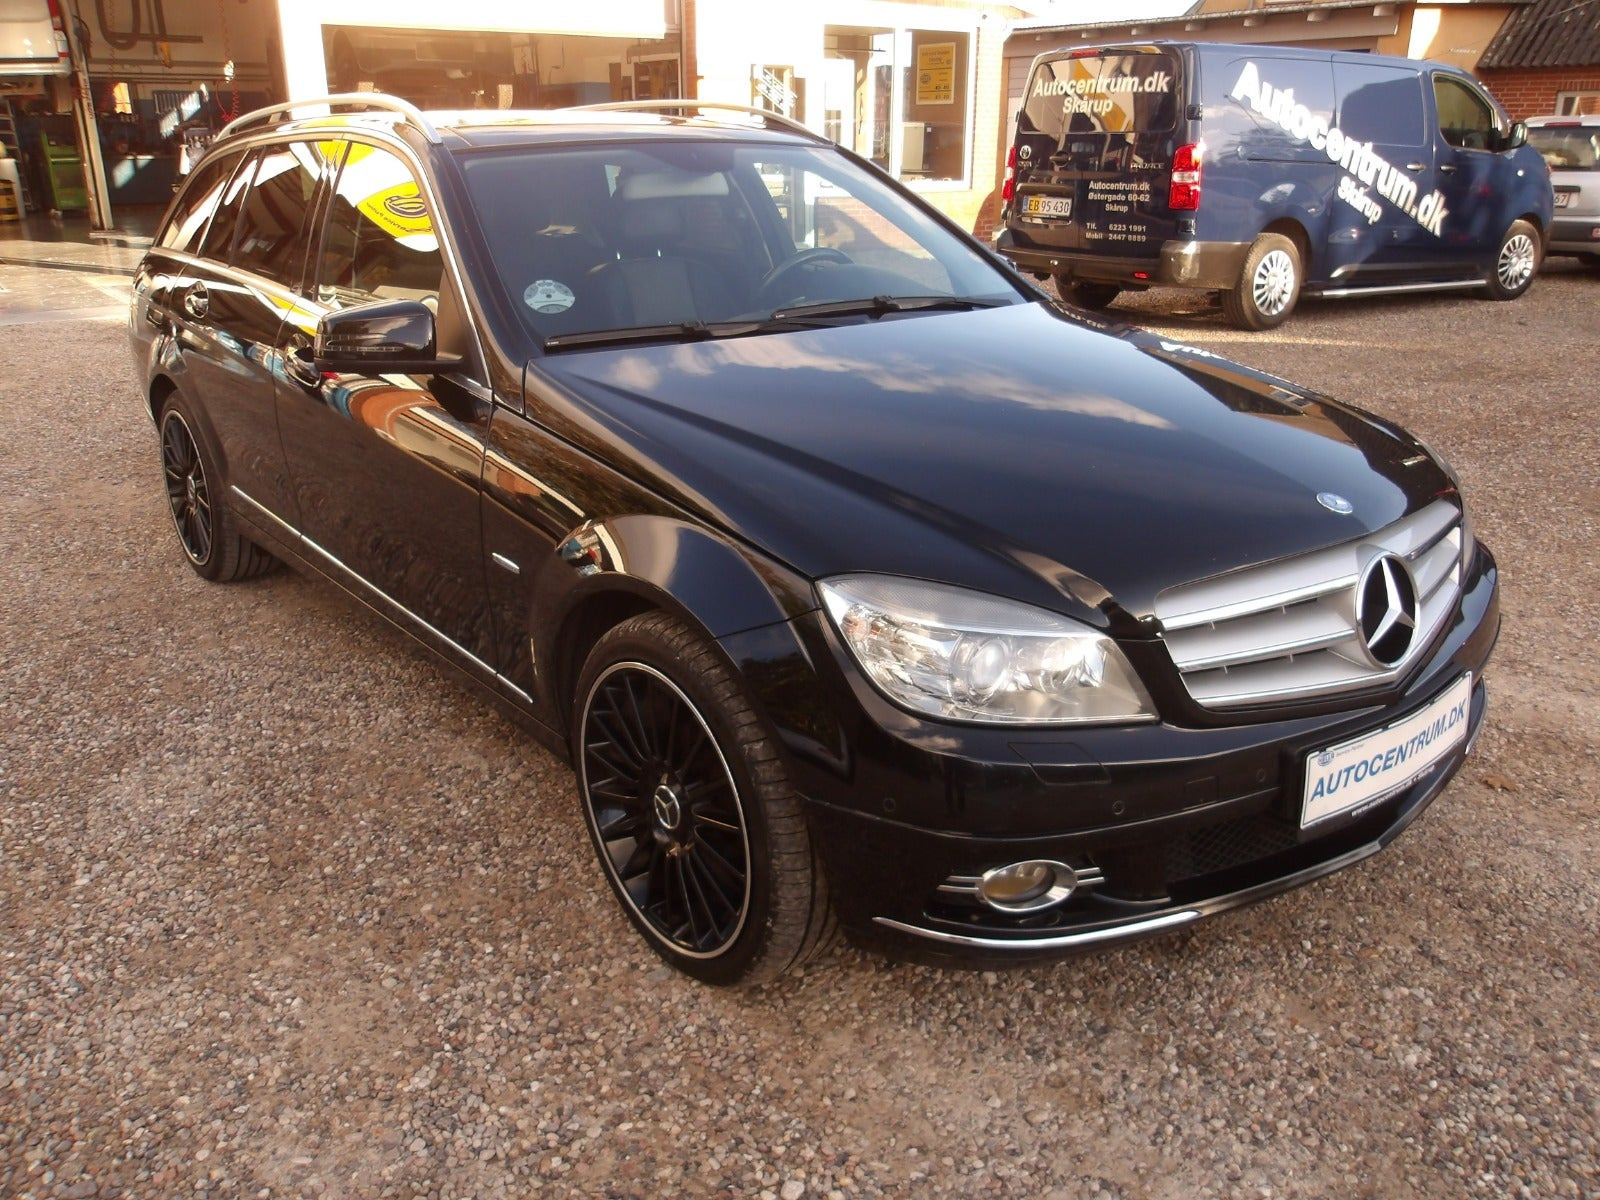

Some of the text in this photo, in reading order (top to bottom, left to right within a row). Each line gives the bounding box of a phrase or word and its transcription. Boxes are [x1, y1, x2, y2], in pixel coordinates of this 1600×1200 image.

[1033, 71, 1171, 97] Autocentrum.dk
[1062, 95, 1113, 116] Skårup
[1231, 61, 1450, 238] Autocentrum.dk
[1088, 180, 1151, 192] Autocentrum.dk
[1028, 199, 1040, 212] EB
[1041, 200, 1051, 212] 95
[1053, 200, 1070, 214] 430
[1127, 193, 1151, 202] 60-62
[1310, 698, 1468, 802] AUTOCENTRUM.DK
